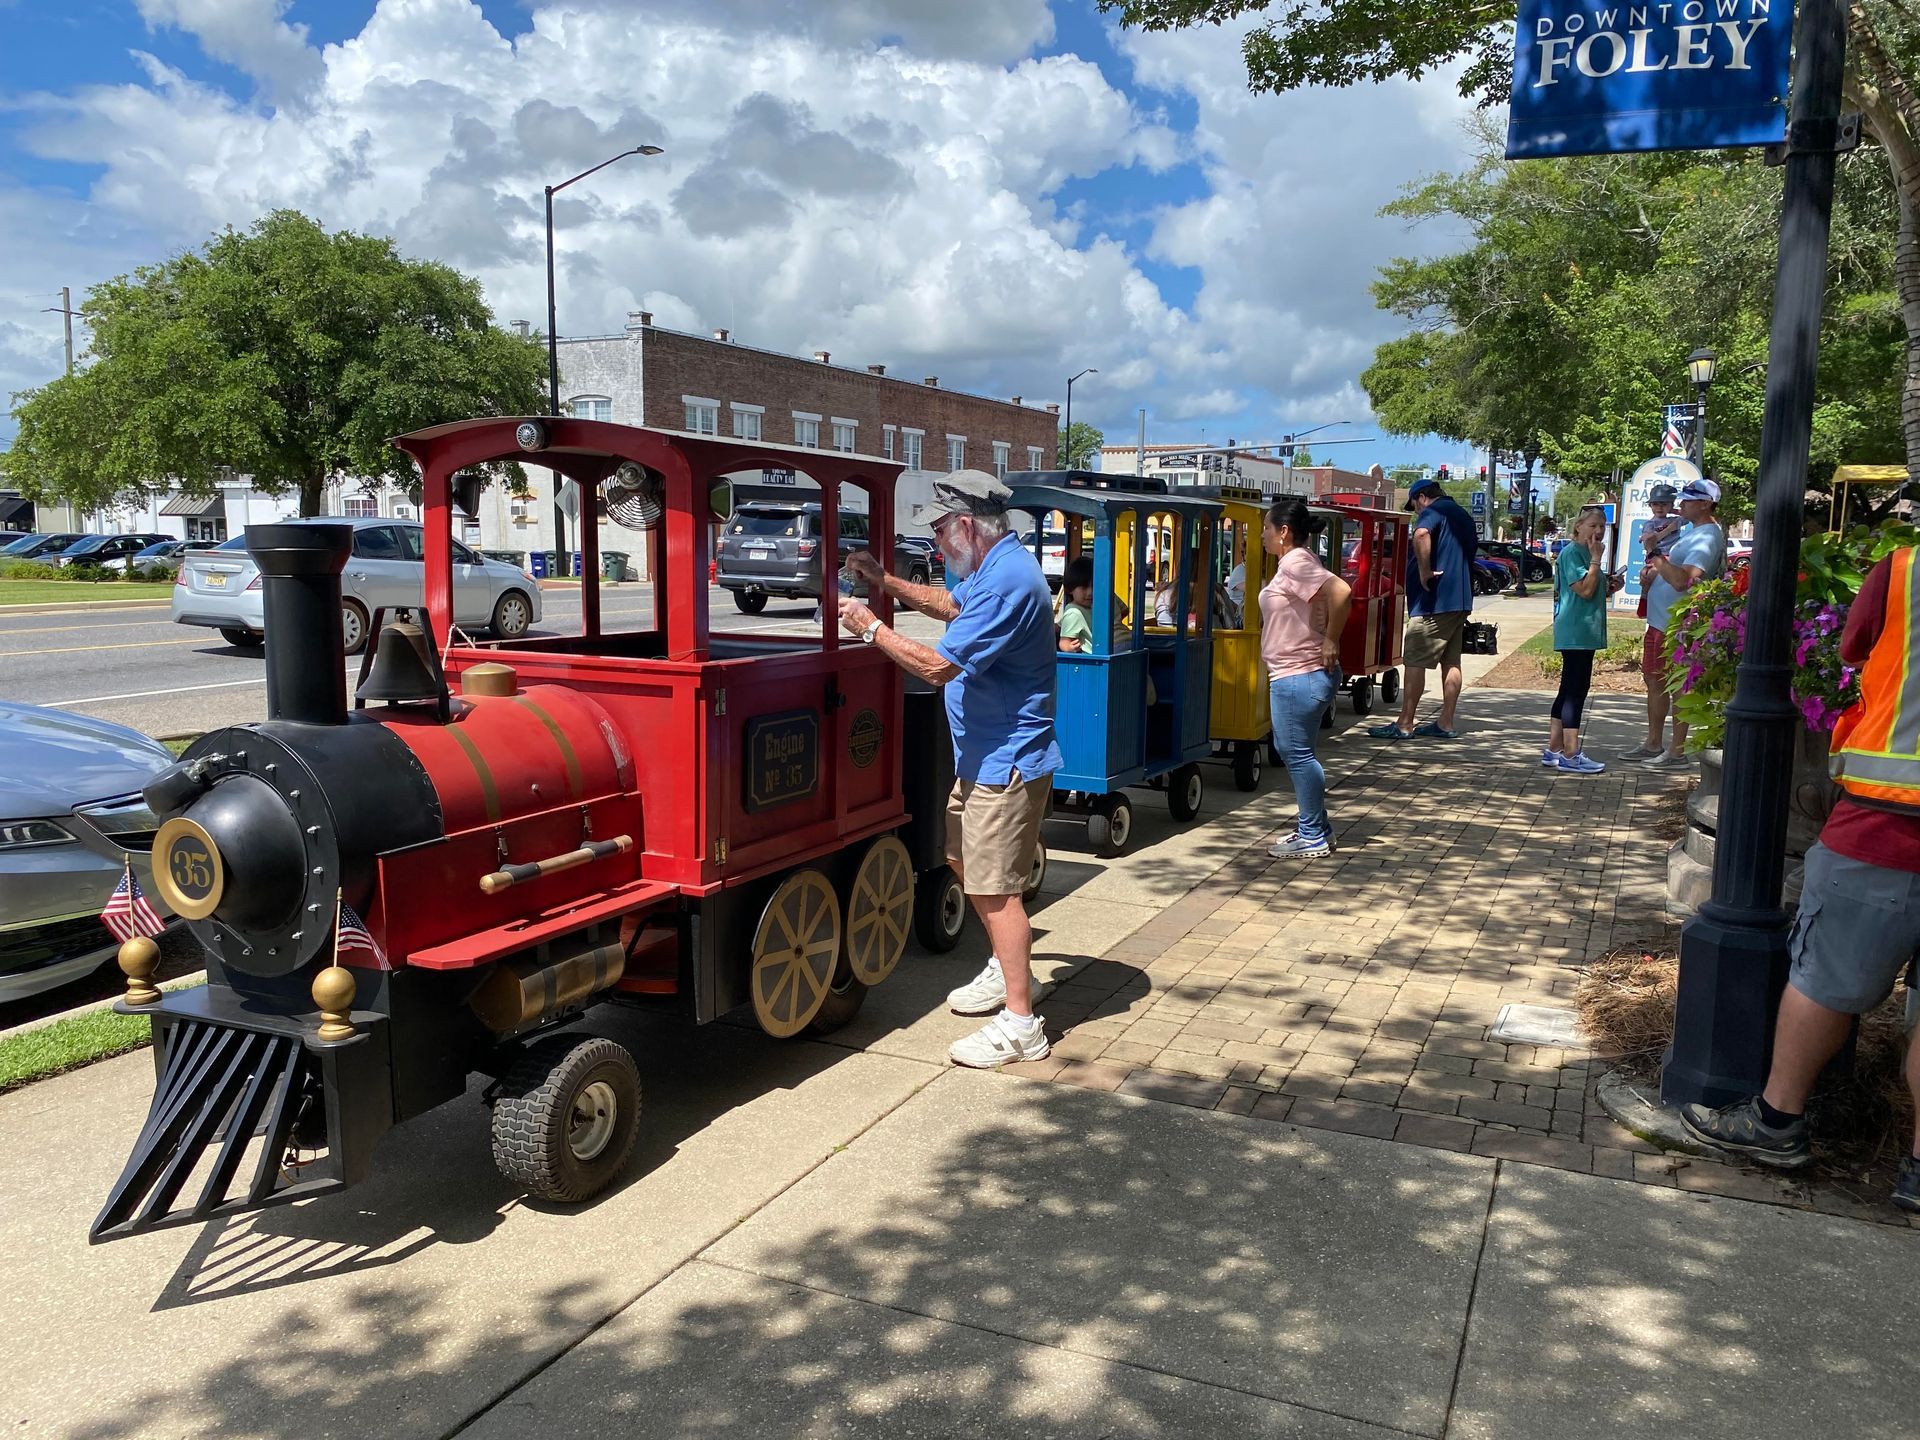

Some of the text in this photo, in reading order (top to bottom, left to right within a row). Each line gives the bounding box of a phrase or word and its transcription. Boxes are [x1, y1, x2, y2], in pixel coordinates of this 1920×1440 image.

[1537, 0, 1771, 37] DOWNTOWN
[1533, 18, 1768, 88] FOLEY
[764, 729, 805, 763] Engine
[174, 850, 210, 888] 35
